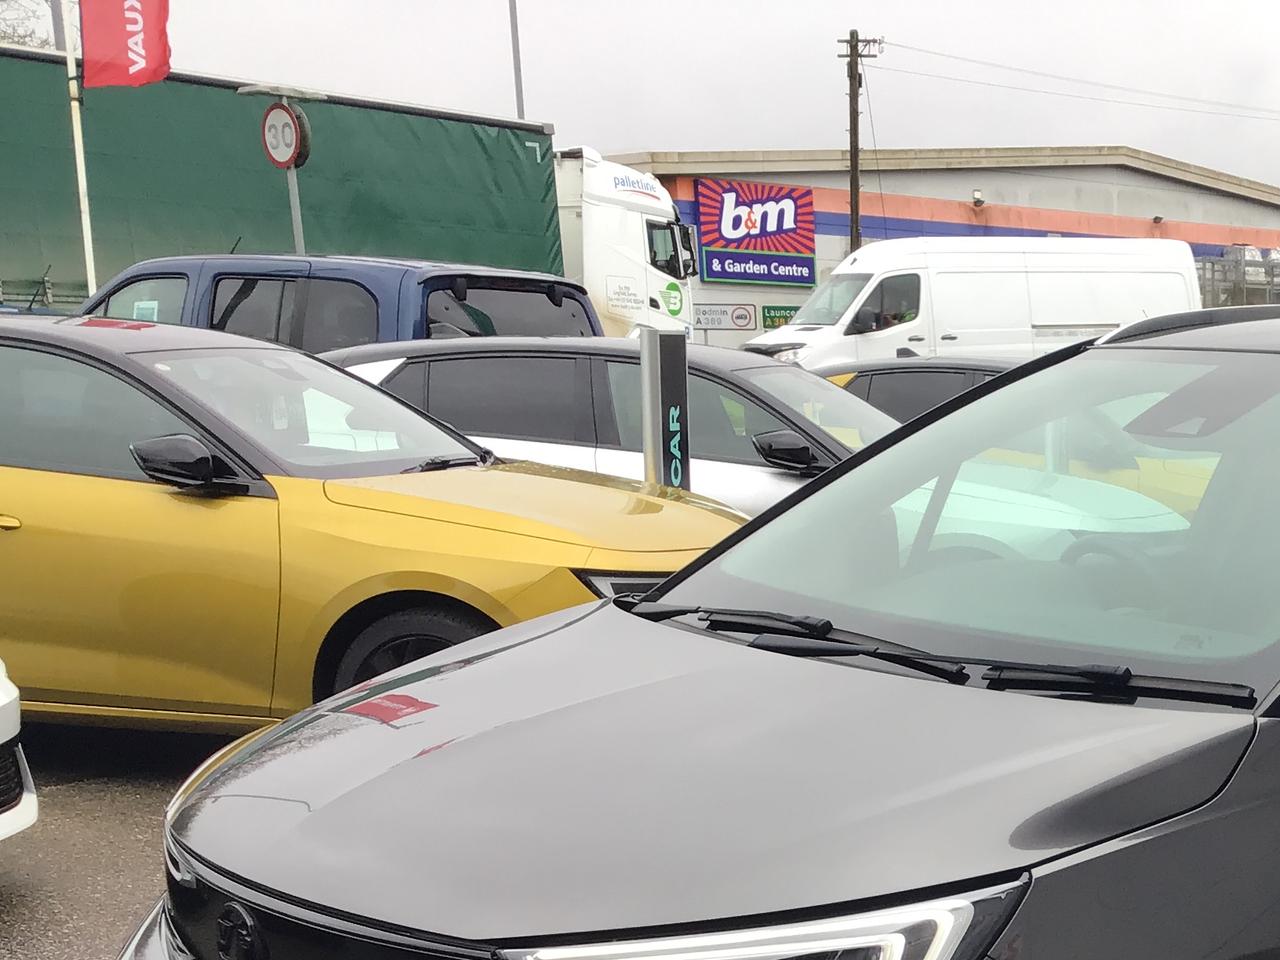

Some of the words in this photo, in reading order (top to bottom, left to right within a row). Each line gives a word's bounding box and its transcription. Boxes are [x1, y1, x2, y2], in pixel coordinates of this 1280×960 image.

[124, 0, 146, 75] VAUX
[268, 122, 293, 149] 30
[613, 175, 657, 192] palletline
[721, 192, 797, 239] b&m
[712, 259, 722, 272] &
[724, 260, 768, 274] Garden
[770, 262, 809, 277] Centre
[695, 307, 728, 316] Bodmin
[765, 308, 796, 317] Launce
